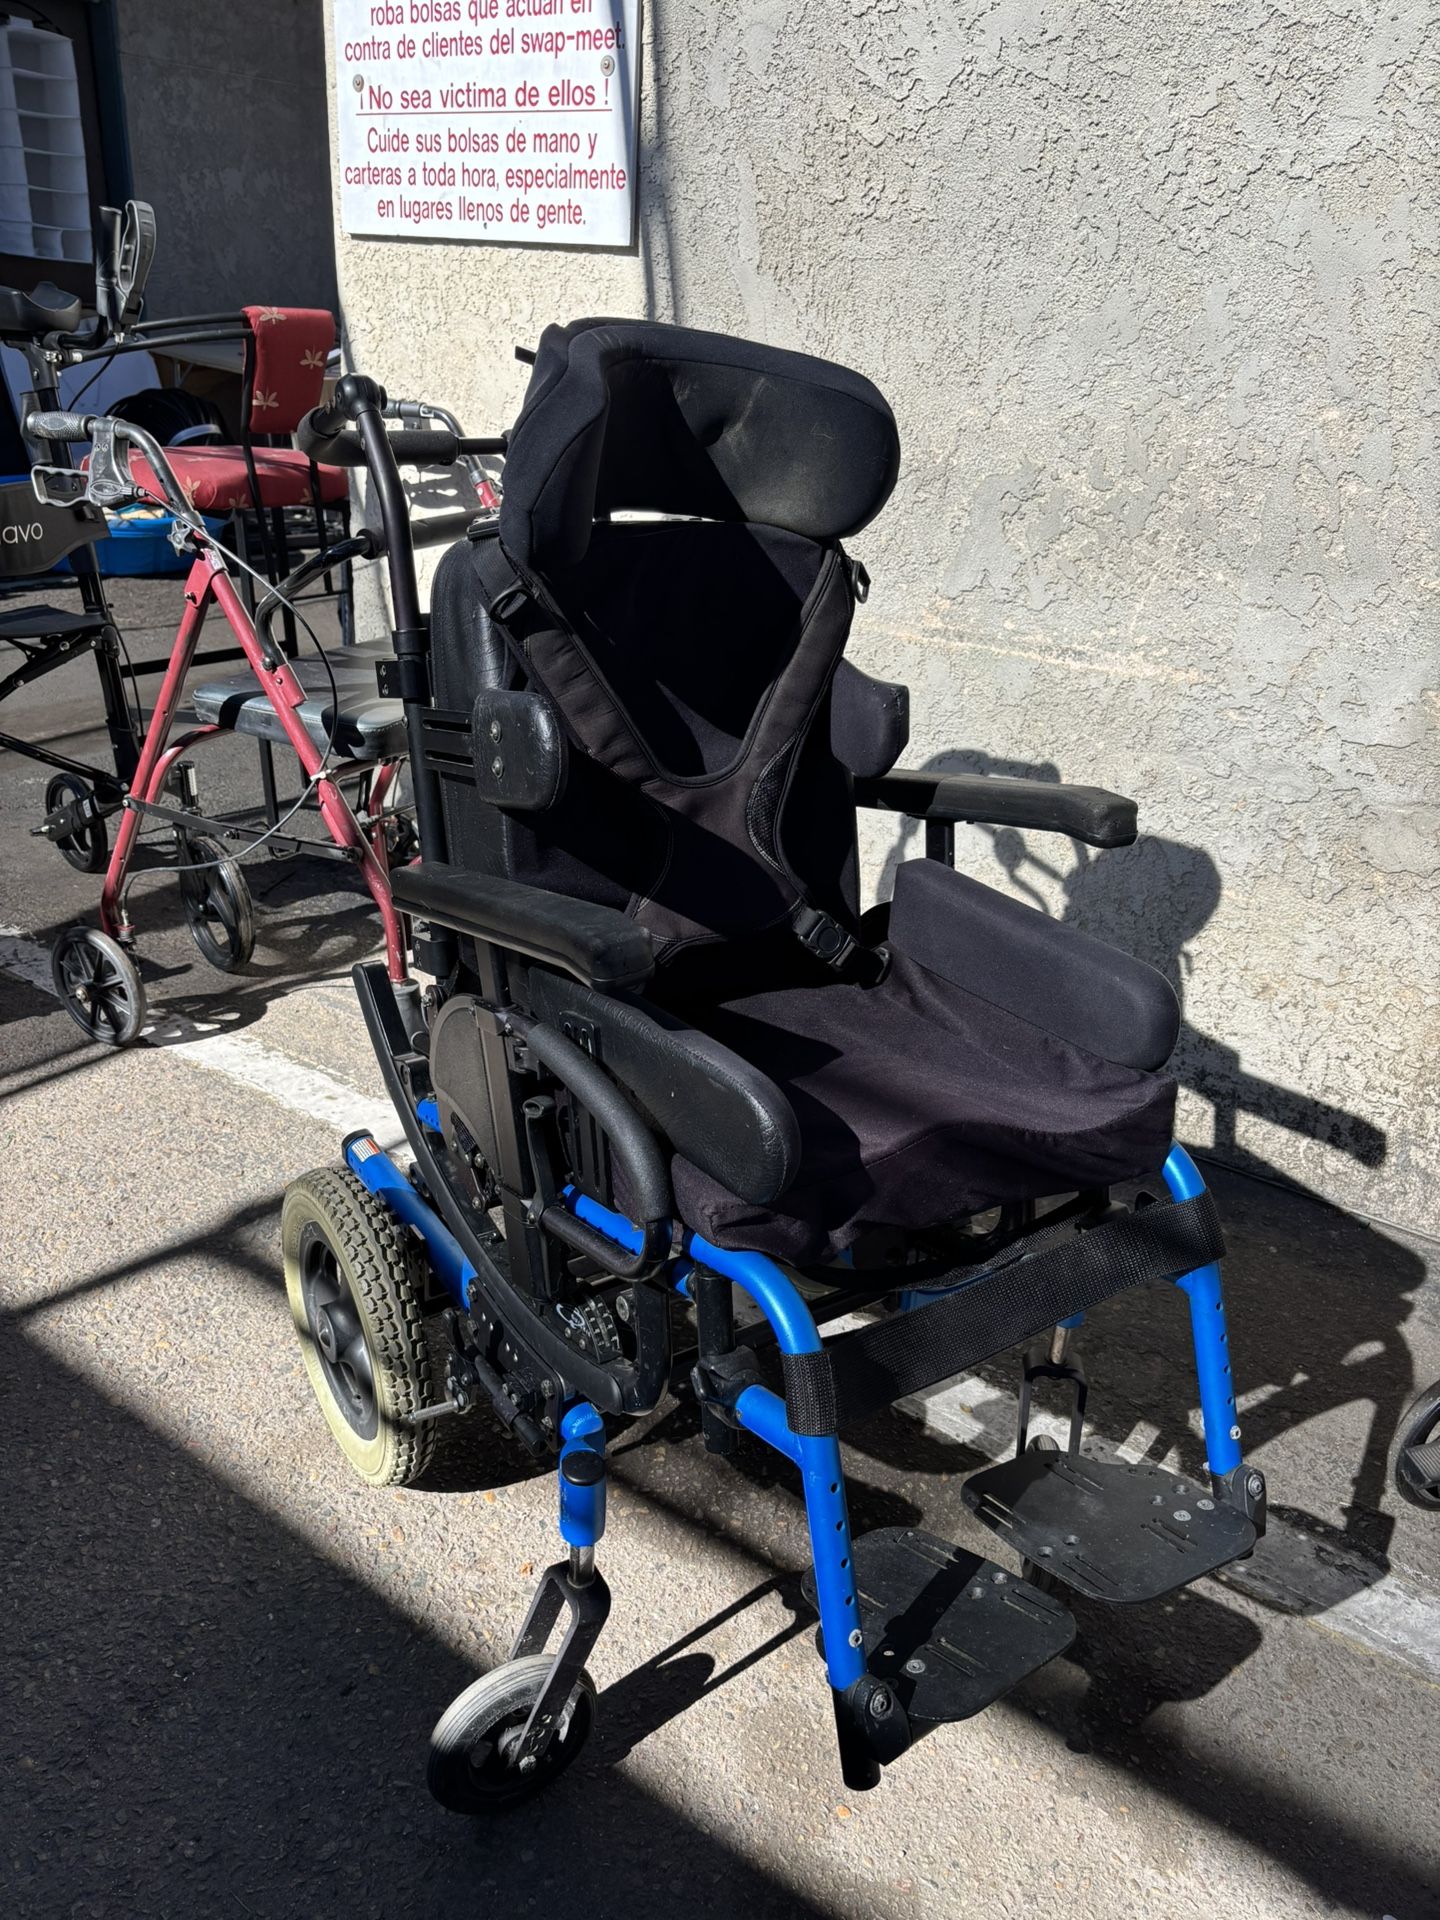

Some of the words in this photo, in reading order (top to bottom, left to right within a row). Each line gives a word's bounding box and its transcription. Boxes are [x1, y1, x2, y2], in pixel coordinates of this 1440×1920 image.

[370, 0, 404, 26] roba
[410, 0, 461, 24] bolsas
[468, 0, 499, 27] que
[344, 35, 391, 62] contra
[397, 33, 416, 59] de
[422, 30, 483, 58] clientes
[490, 27, 514, 55] del
[521, 21, 626, 59] swap-meet.
[400, 89, 432, 109] sea
[439, 81, 507, 109] victima
[515, 80, 540, 107] de
[548, 78, 596, 106] ellos
[367, 126, 410, 153] Cuide
[416, 133, 442, 153] sus
[448, 127, 500, 153] bolsas
[506, 126, 527, 153] de
[533, 132, 580, 153] mano
[587, 132, 598, 160] y
[345, 161, 402, 186] carteras
[408, 166, 417, 186] a
[422, 161, 456, 187] toda
[461, 161, 500, 192] hora,
[505, 162, 627, 195] especialmente
[377, 199, 395, 218] en
[400, 194, 453, 224] lugares
[458, 195, 504, 222] llenos
[510, 197, 530, 223] de
[536, 198, 586, 229] gente.
[0, 522, 43, 544] avo
